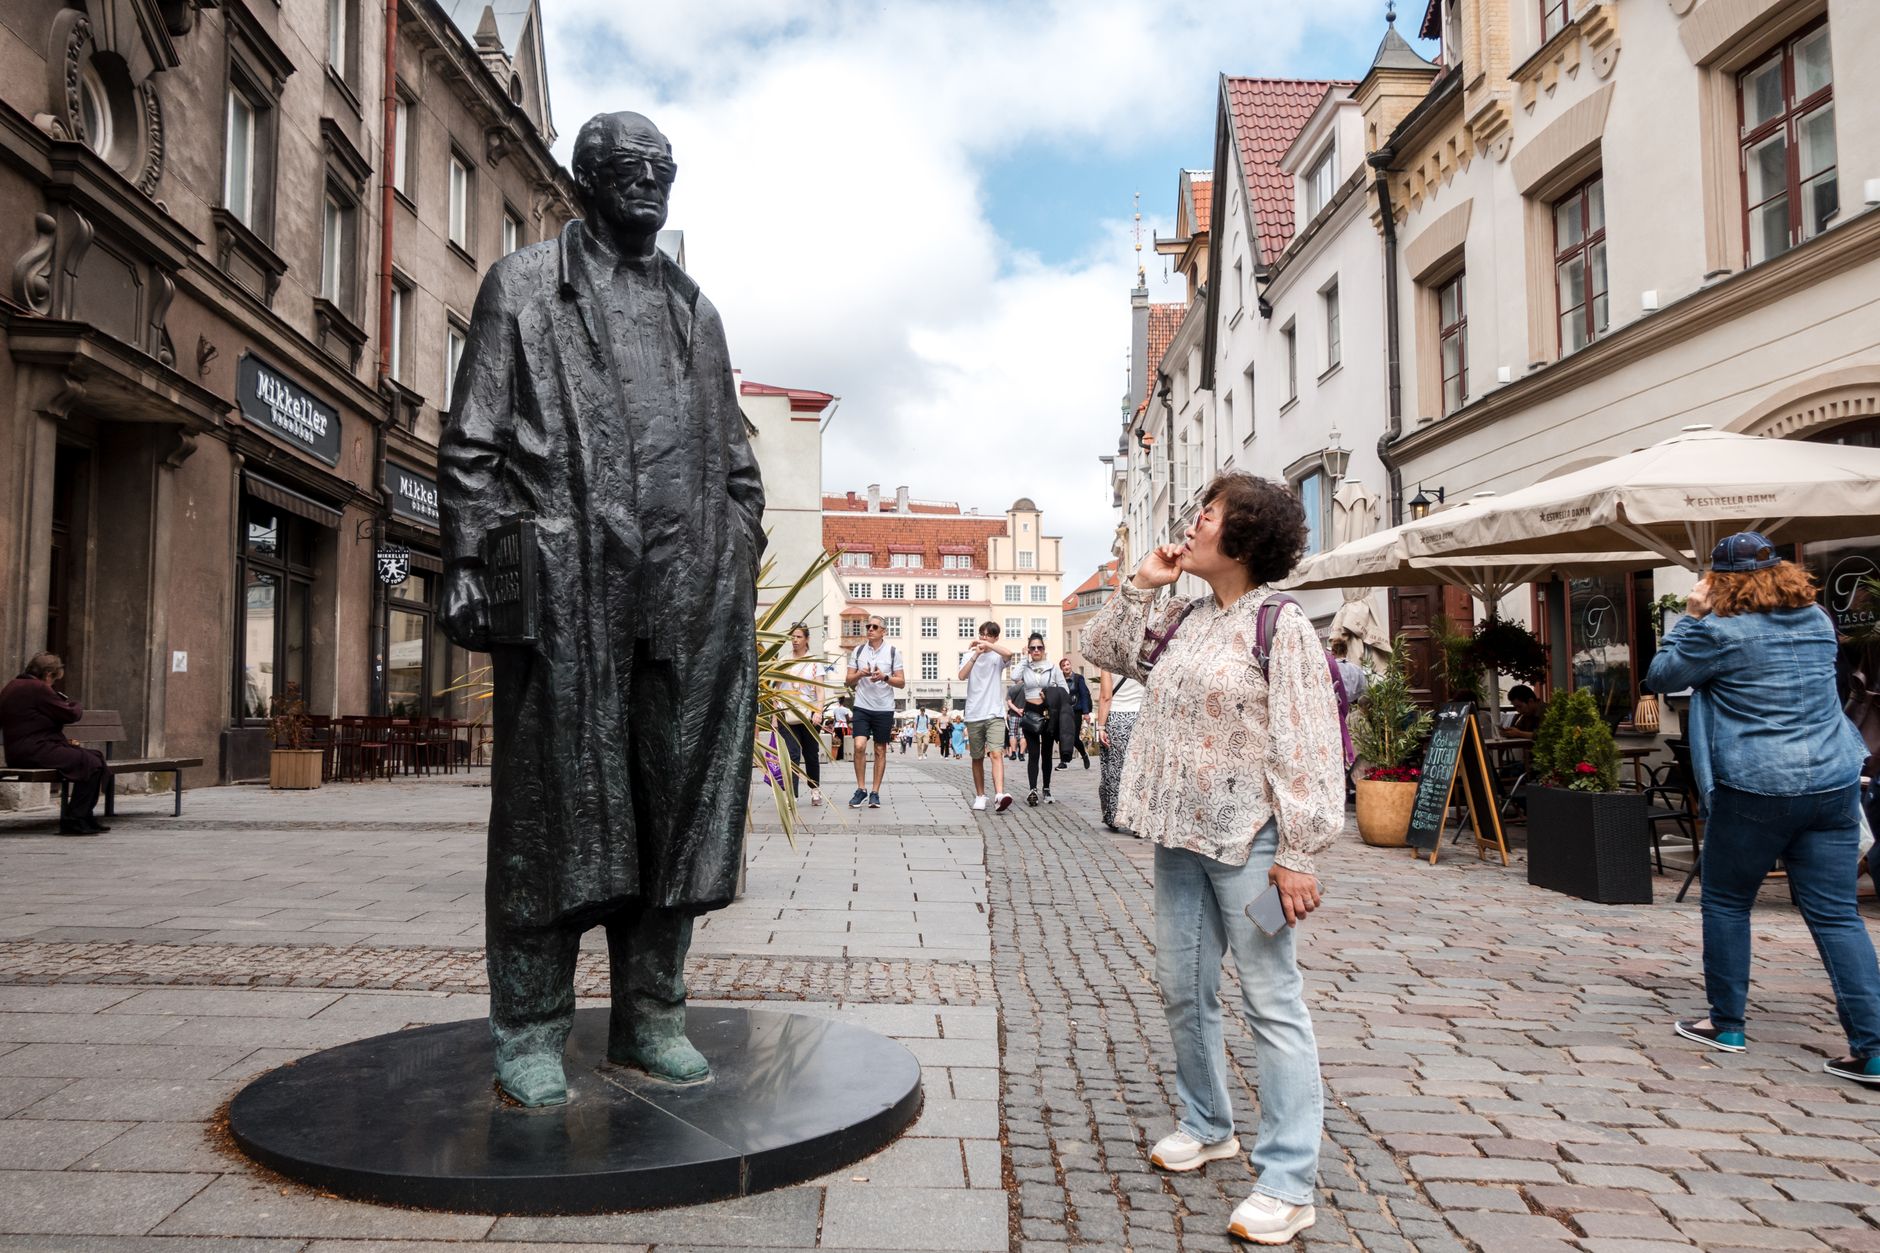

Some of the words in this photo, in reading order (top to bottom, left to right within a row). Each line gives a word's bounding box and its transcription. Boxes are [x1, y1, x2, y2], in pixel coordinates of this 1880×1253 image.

[256, 370, 327, 437] Mikkeller
[1697, 496, 1744, 507] ESTRELLA
[1746, 494, 1777, 503] DAMM
[1571, 507, 1590, 517] DAMM
[380, 574, 390, 584] OLD
[390, 574, 405, 584] TOWN
[1837, 610, 1875, 623] TASCA
[1589, 638, 1611, 647] TASCA
